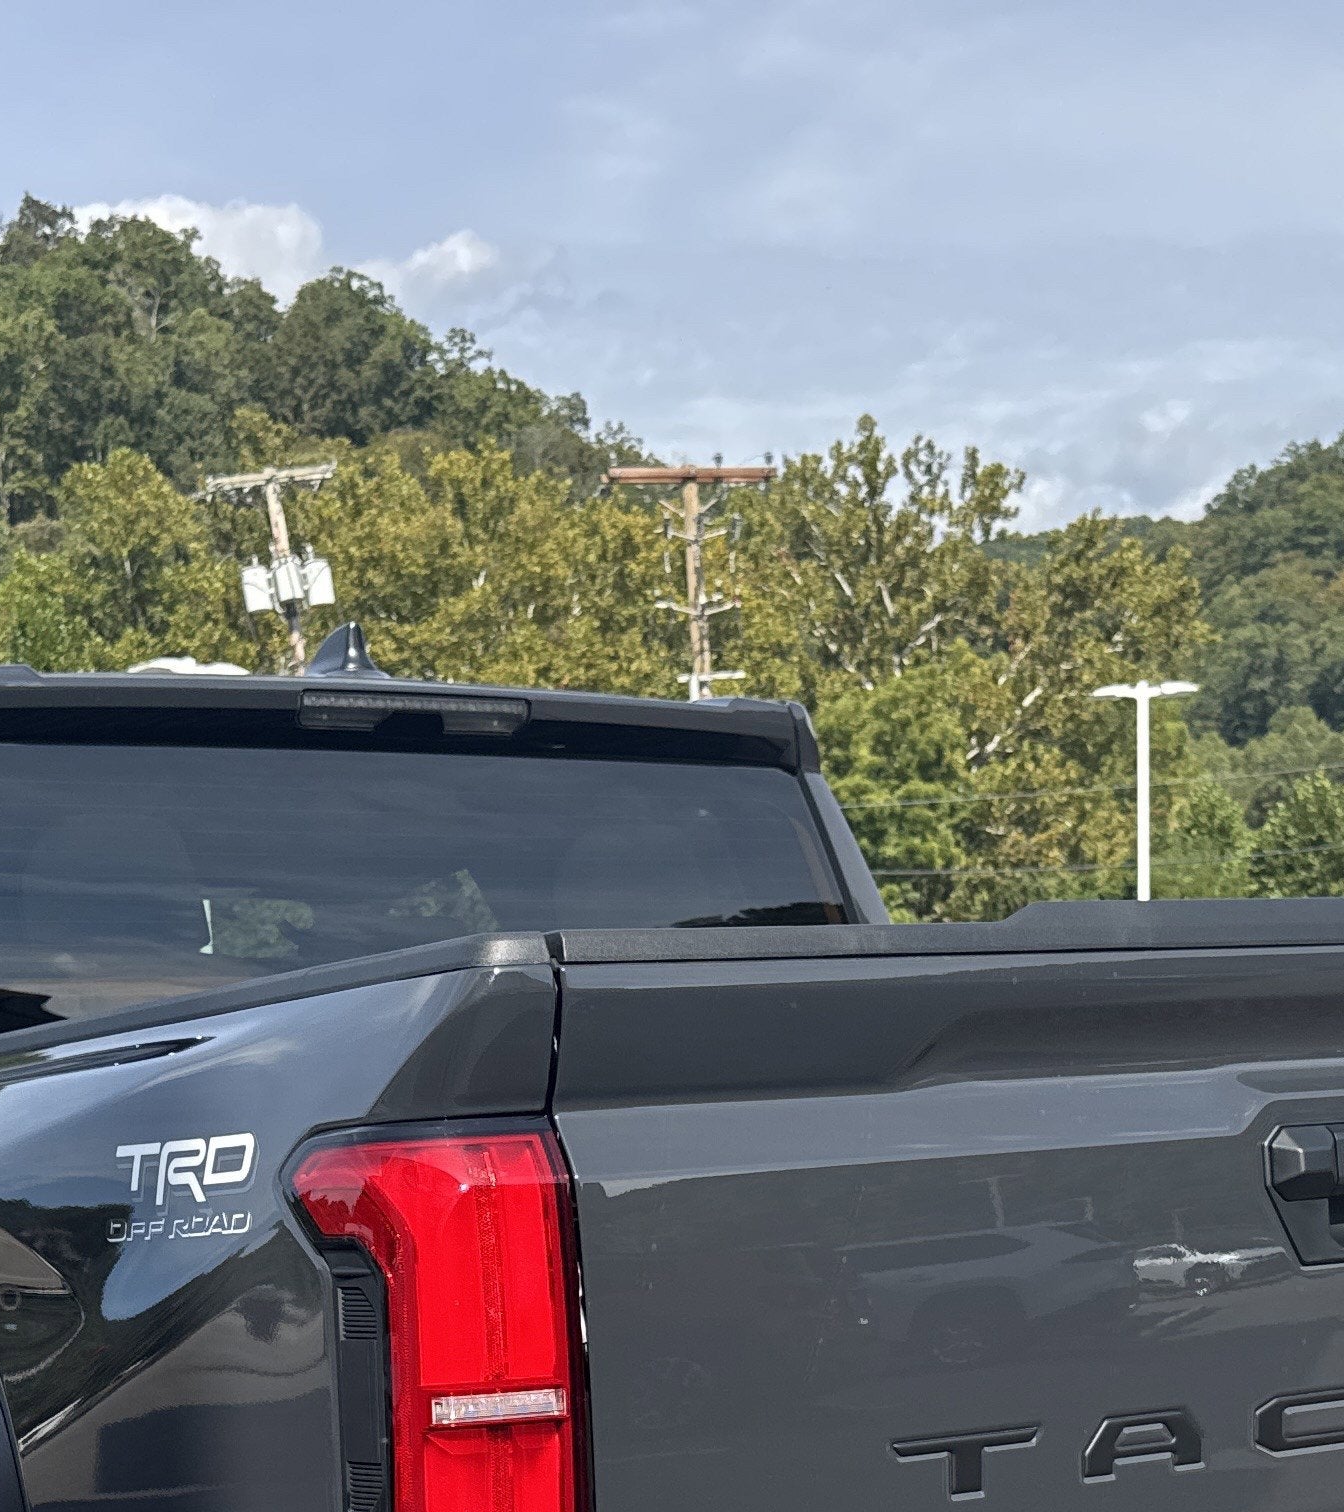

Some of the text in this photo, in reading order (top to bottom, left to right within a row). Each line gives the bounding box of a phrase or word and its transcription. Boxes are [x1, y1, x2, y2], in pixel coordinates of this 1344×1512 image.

[115, 1132, 255, 1206] TRD
[106, 1211, 253, 1243] OFF ROAD
